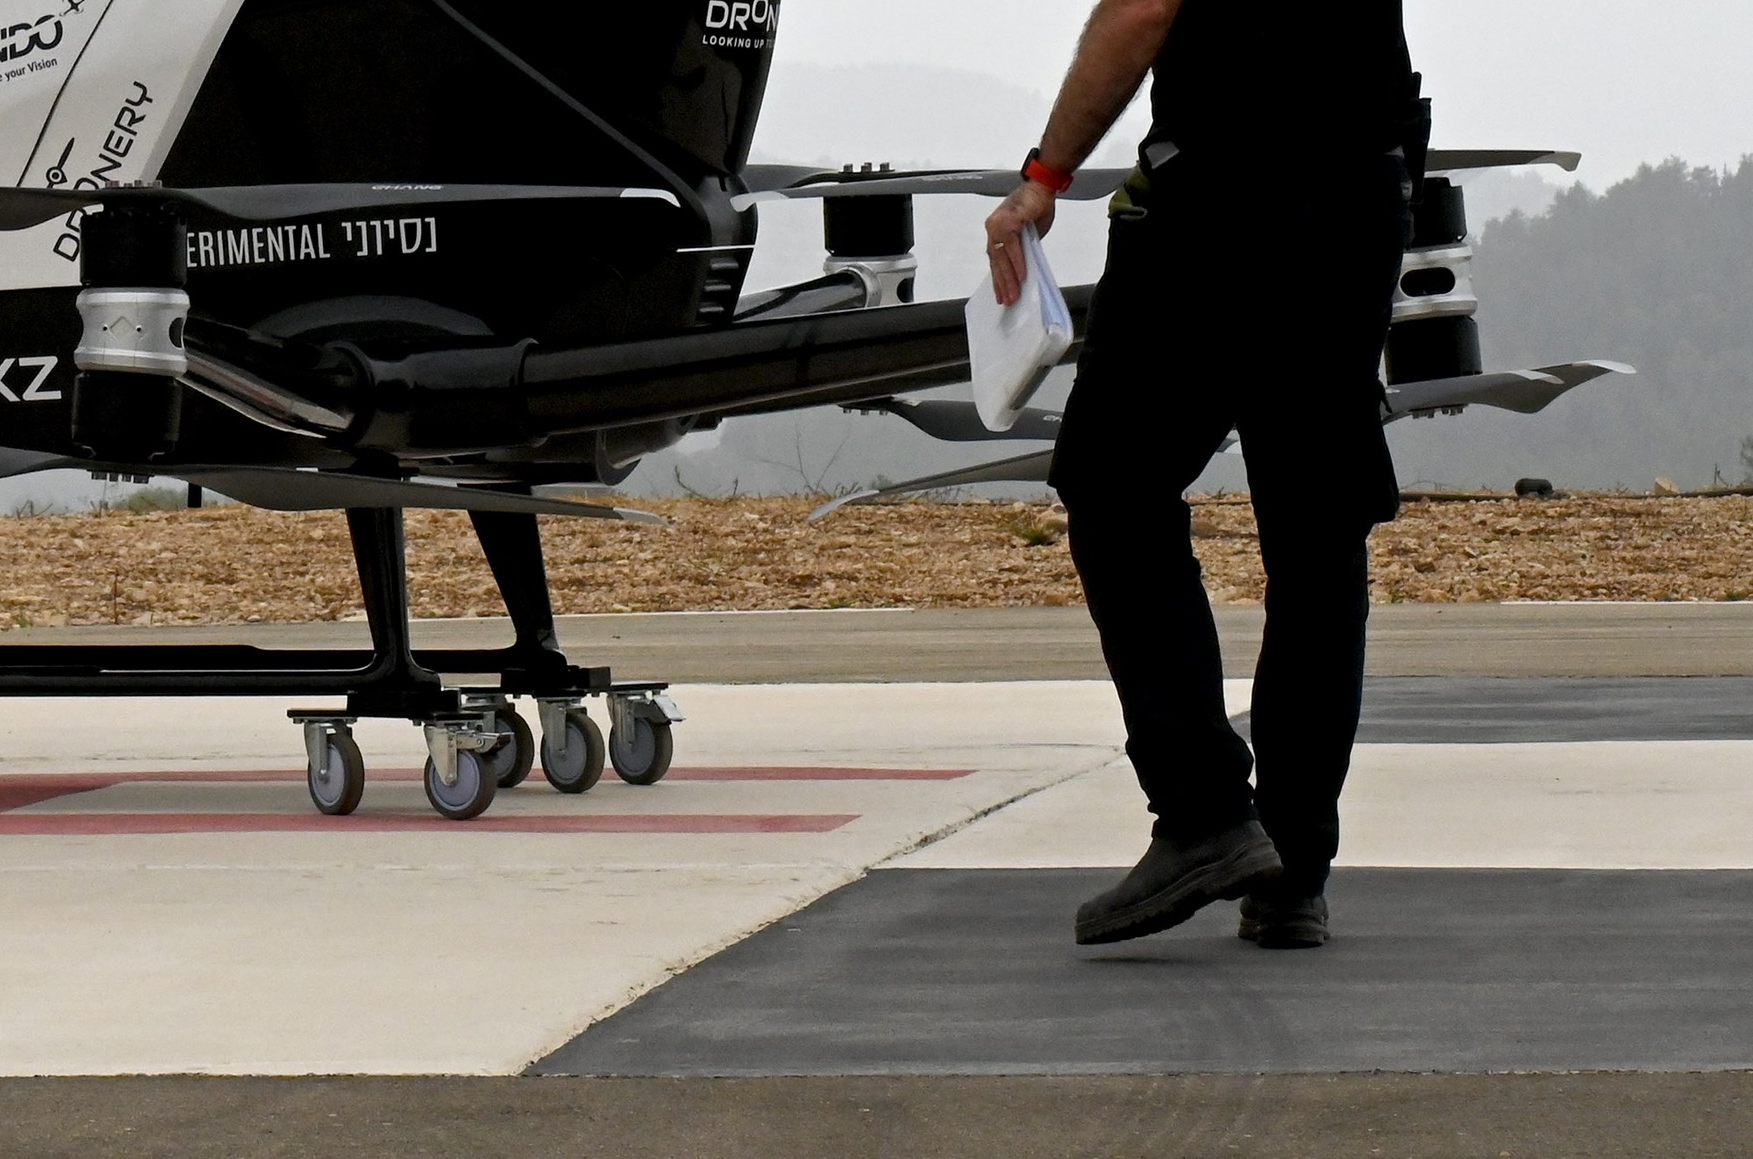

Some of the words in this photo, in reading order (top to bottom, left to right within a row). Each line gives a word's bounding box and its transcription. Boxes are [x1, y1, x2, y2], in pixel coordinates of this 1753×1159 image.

[702, 34, 751, 49] LOOKING
[4, 67, 26, 81] your
[27, 58, 58, 72] Vision
[186, 223, 331, 268] ERIMENTAL
[341, 217, 437, 257] נסיוני
